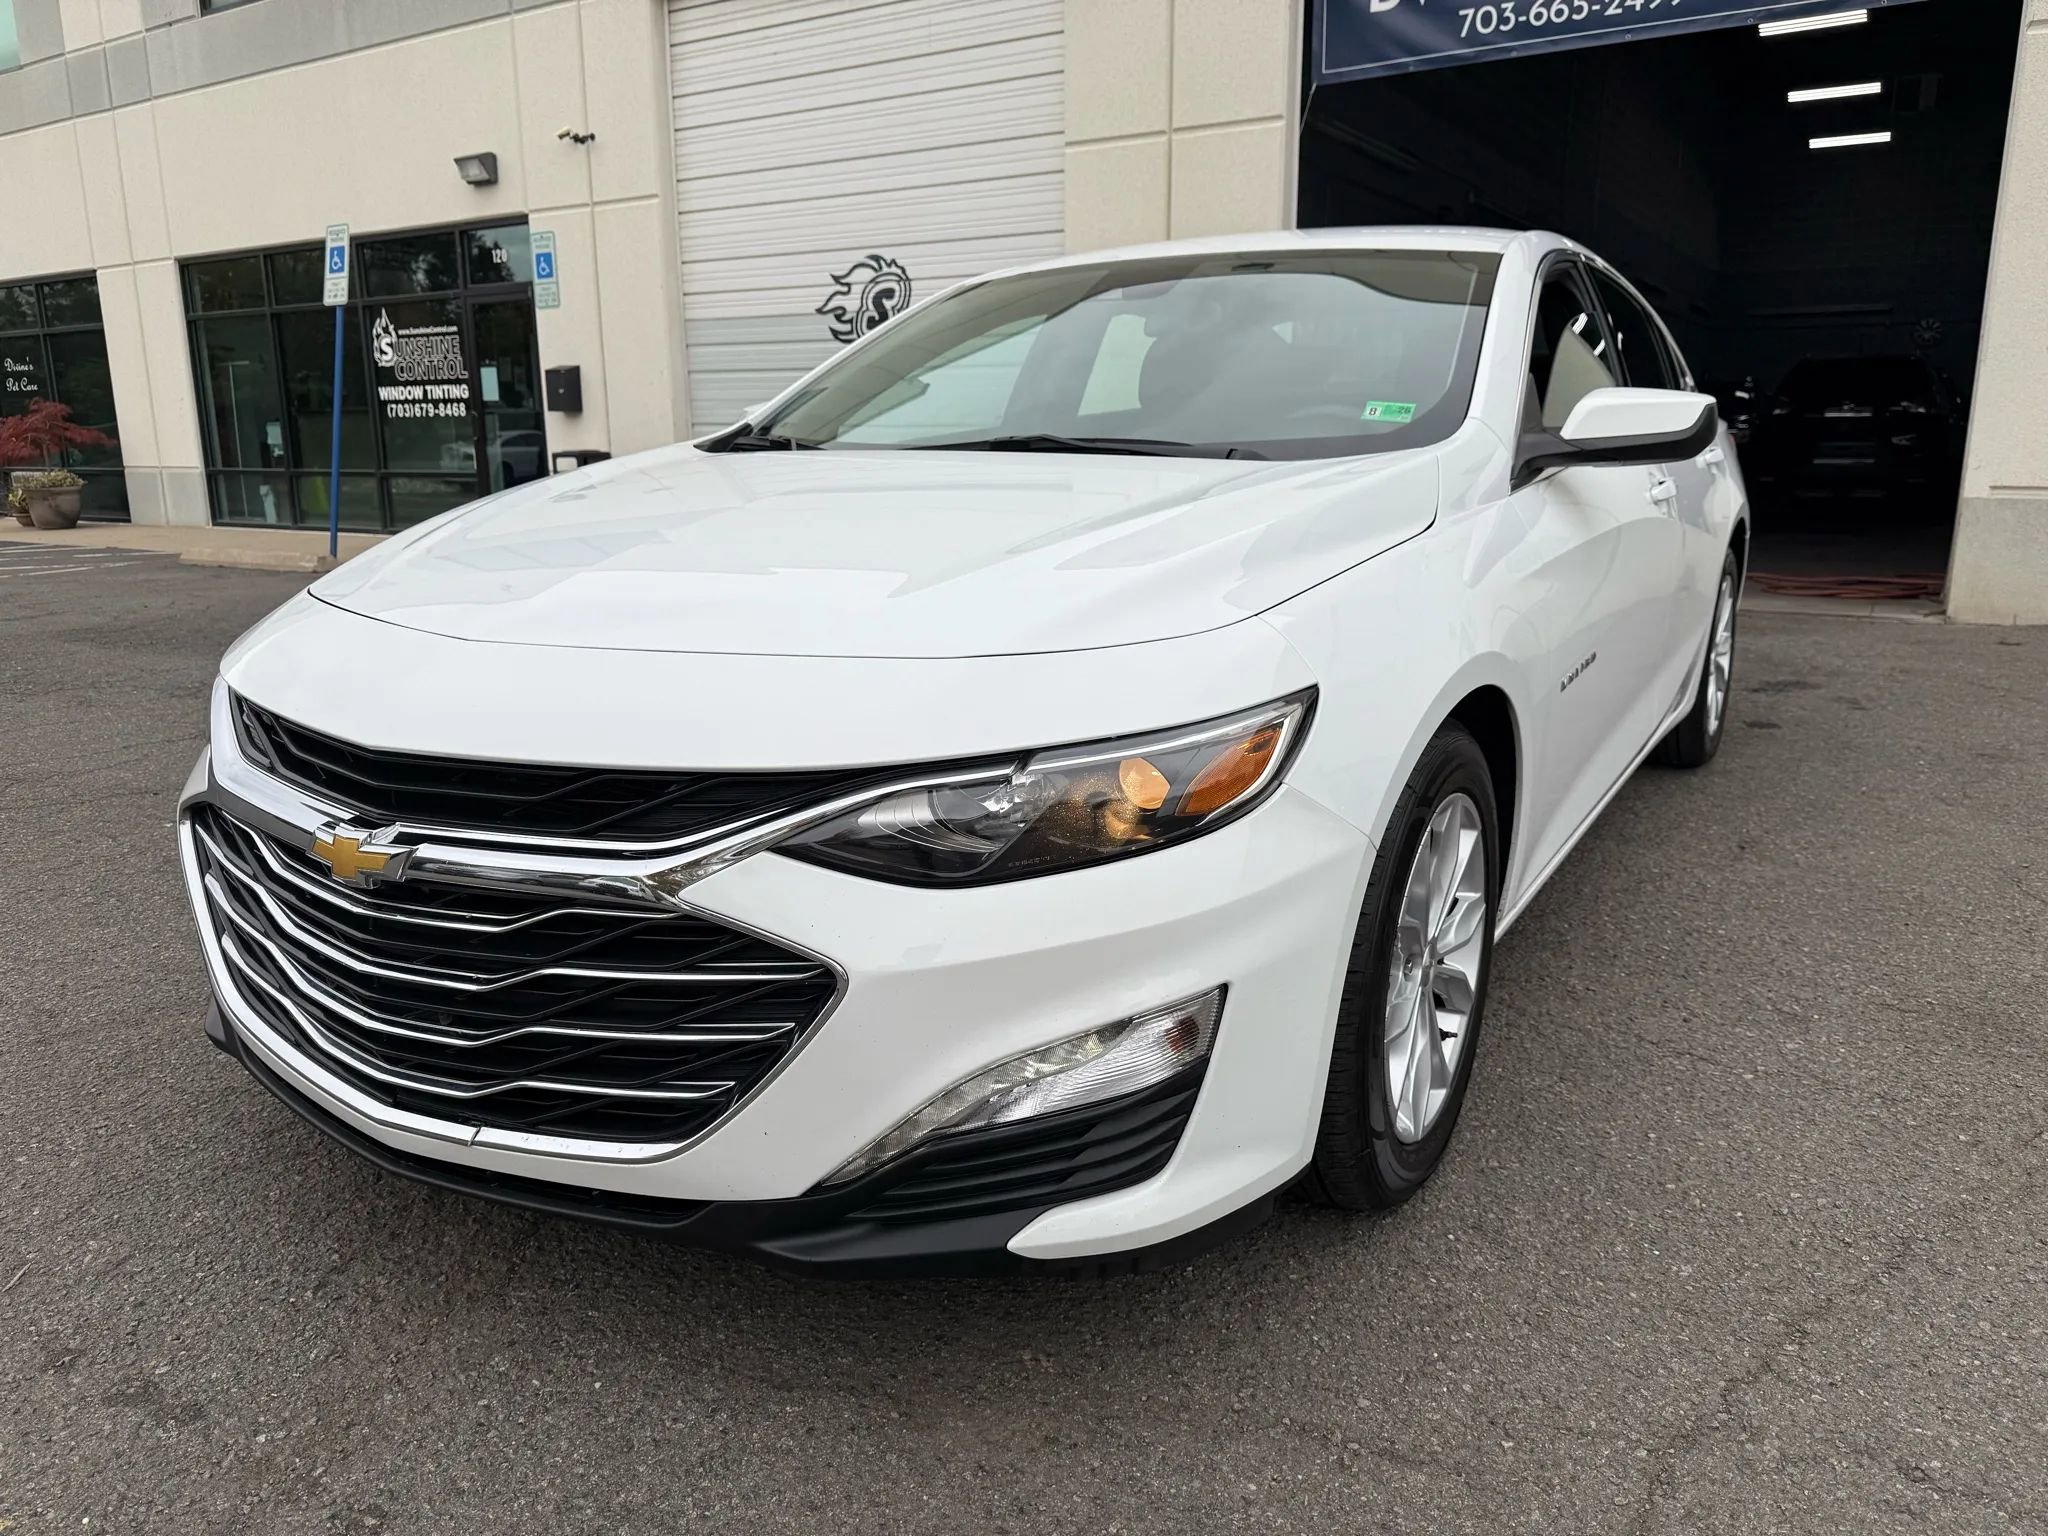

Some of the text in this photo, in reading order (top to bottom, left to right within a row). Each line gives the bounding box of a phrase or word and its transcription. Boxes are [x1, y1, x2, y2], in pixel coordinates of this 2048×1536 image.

[492, 249, 507, 263] 120
[379, 335, 461, 362] SUNSHINE
[394, 357, 469, 381] CONTROL
[6, 377, 38, 391] Pet Care
[378, 384, 469, 400] WINDOW TINTING
[387, 402, 466, 418] (703)679-8468
[1369, 407, 1377, 415] 8
